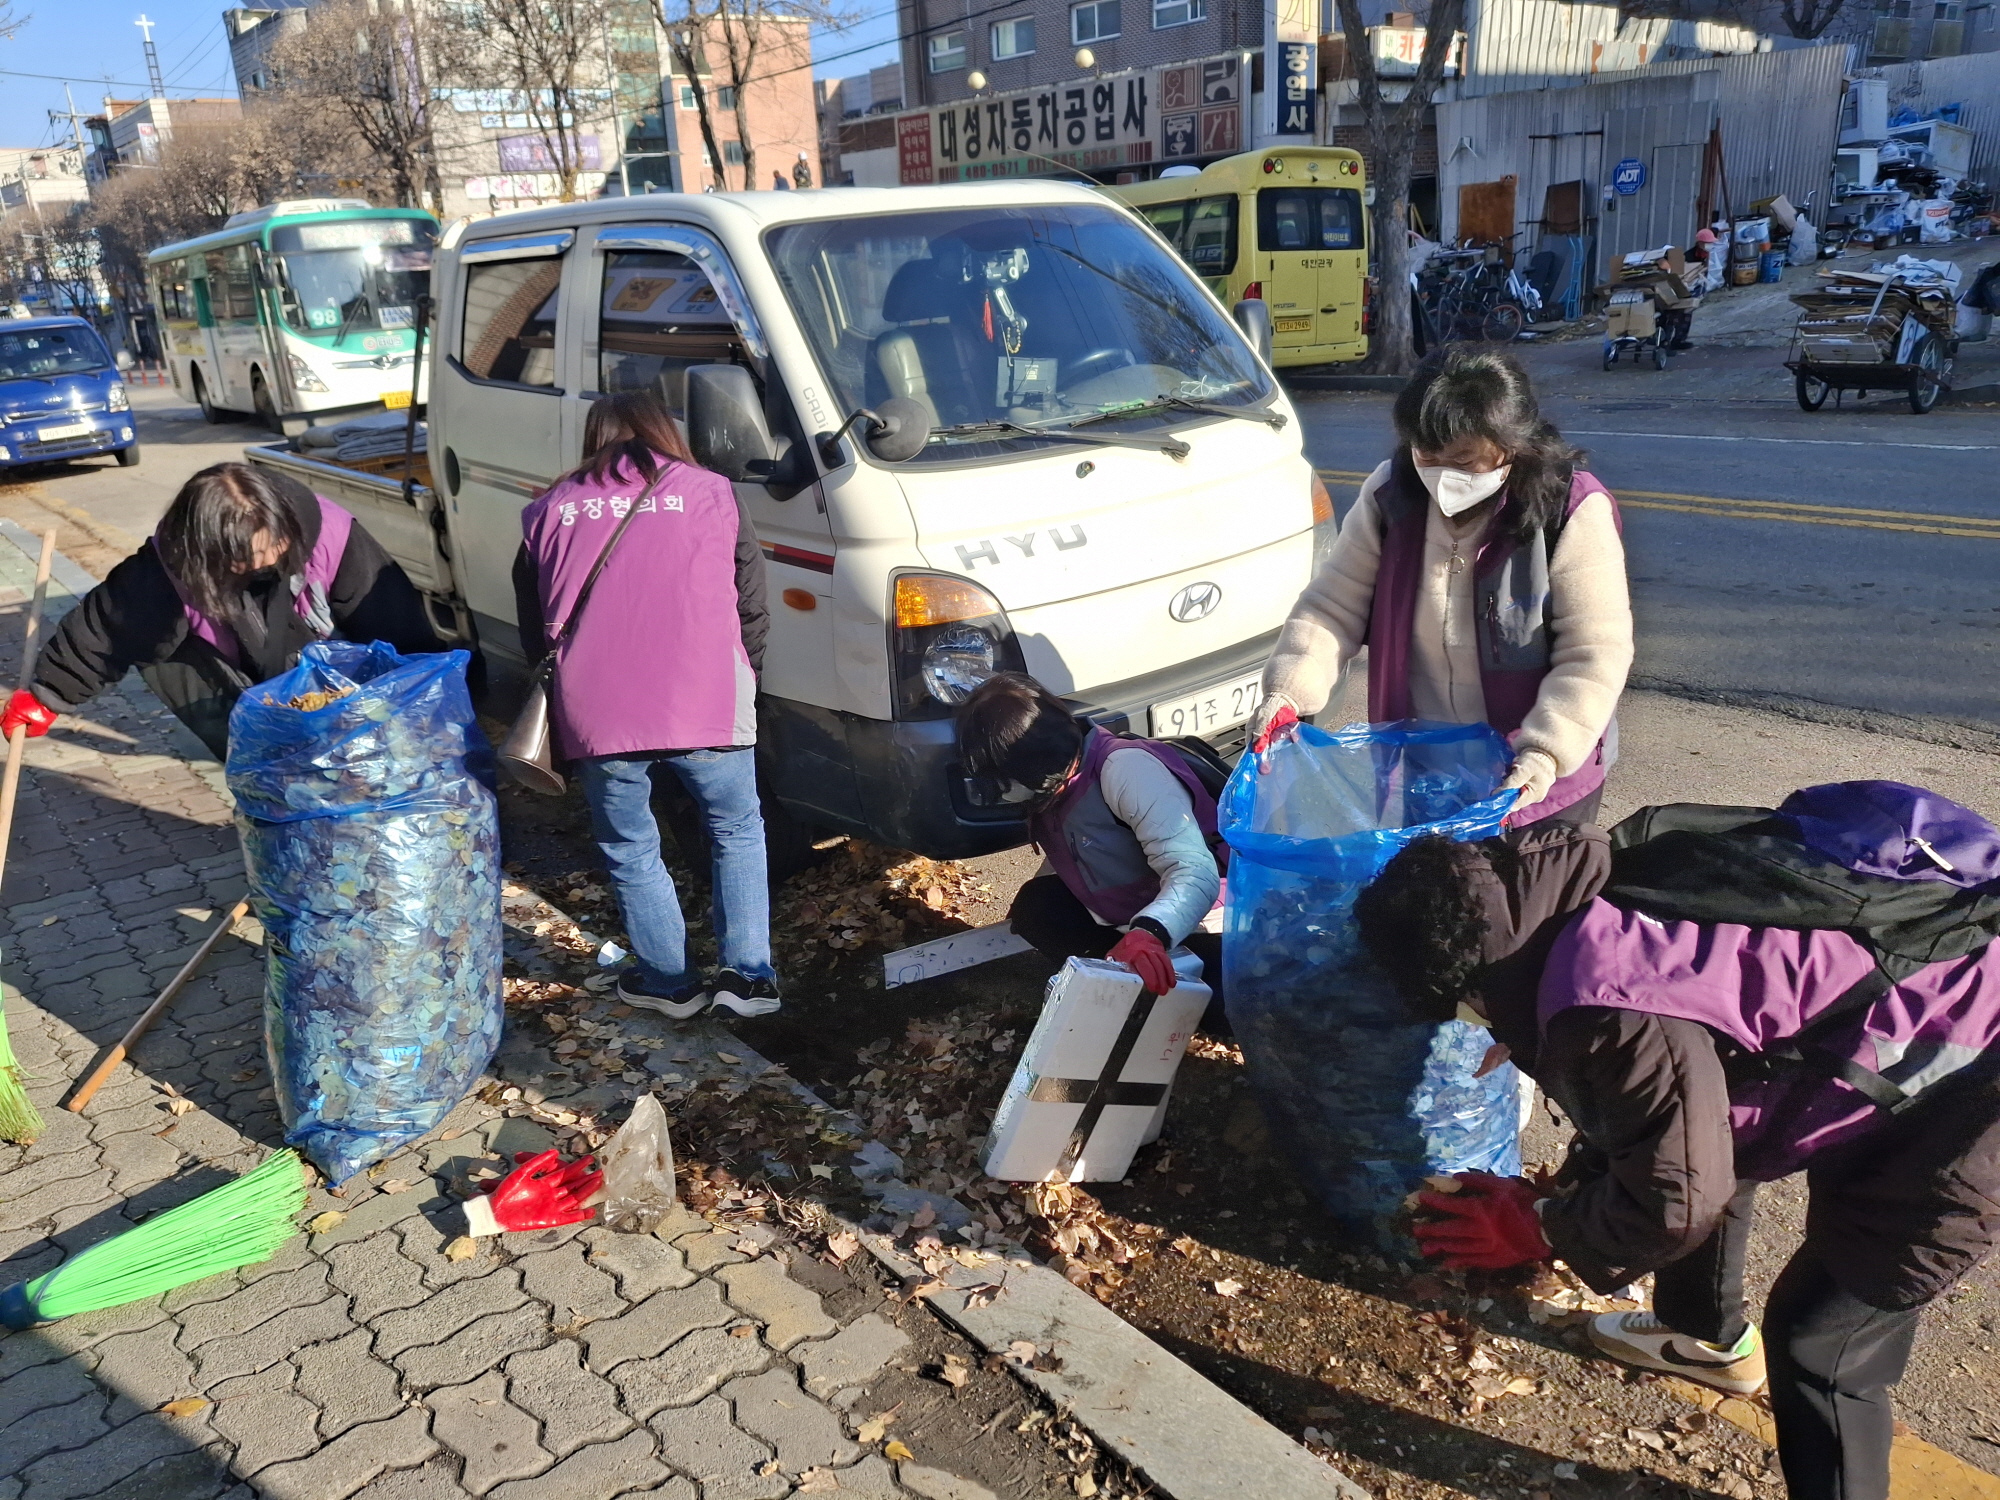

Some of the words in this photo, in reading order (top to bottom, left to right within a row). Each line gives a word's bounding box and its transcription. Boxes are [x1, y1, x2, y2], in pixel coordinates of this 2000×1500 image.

[1285, 45, 1309, 131] 공업사
[939, 77, 1147, 162] 대성자동차공업사
[1617, 169, 1640, 183] ADT
[1301, 258, 1333, 269] 대한관광
[311, 310, 337, 326] 98
[559, 494, 684, 526] 통장협의회
